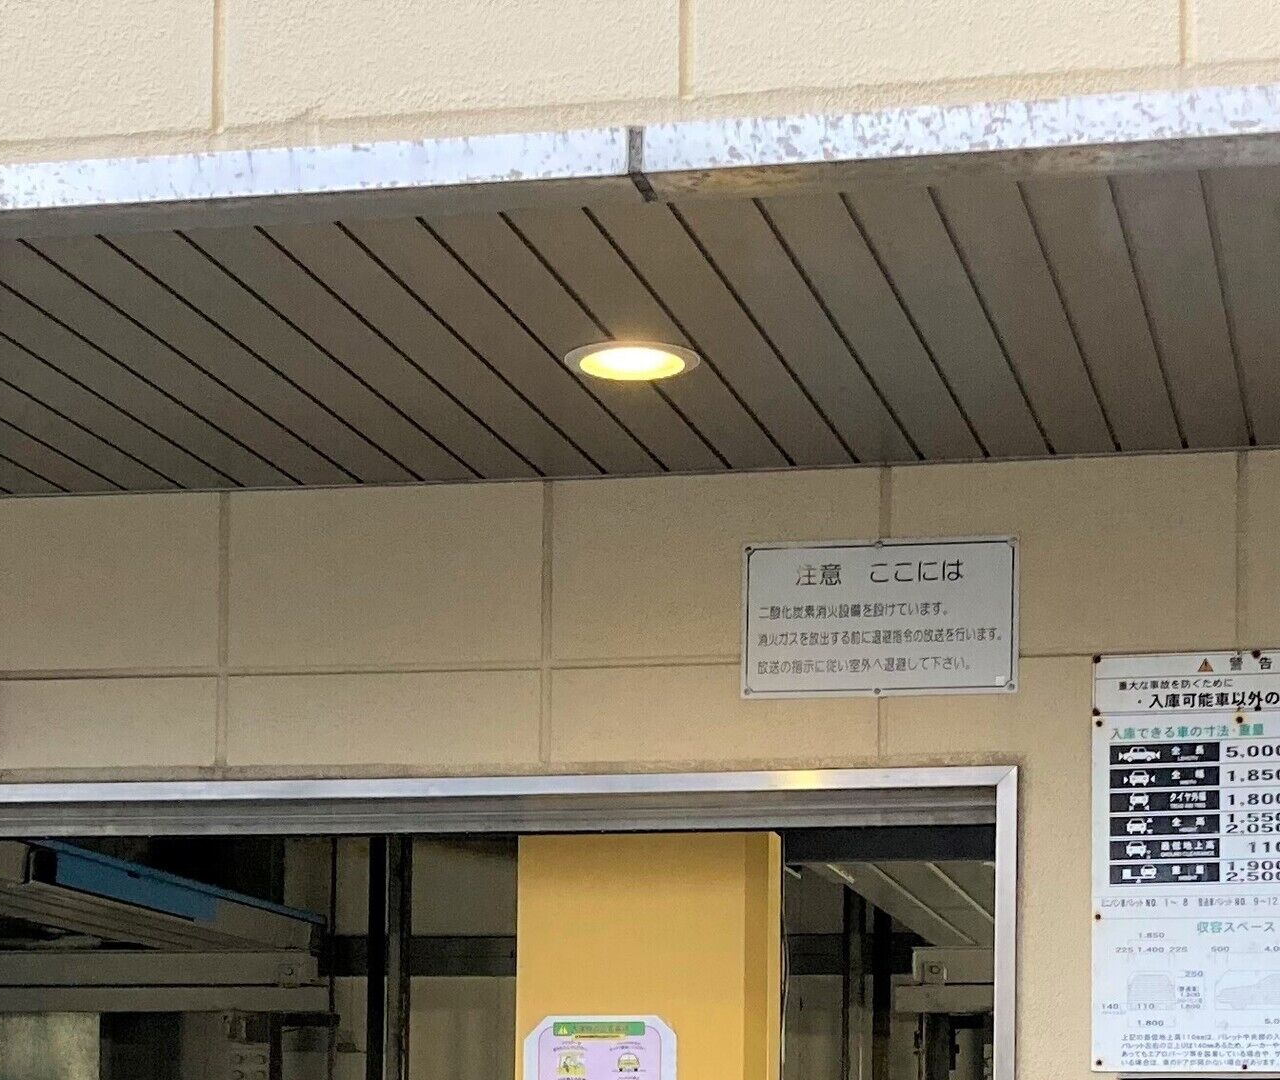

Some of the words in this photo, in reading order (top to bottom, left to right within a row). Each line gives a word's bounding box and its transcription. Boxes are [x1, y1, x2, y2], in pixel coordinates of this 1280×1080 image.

[795, 563, 843, 587] 注意
[869, 558, 965, 583] ここには
[1110, 724, 1265, 741] 入庫できる車の寸法・重量
[1197, 921, 1275, 934] 収容スペース
